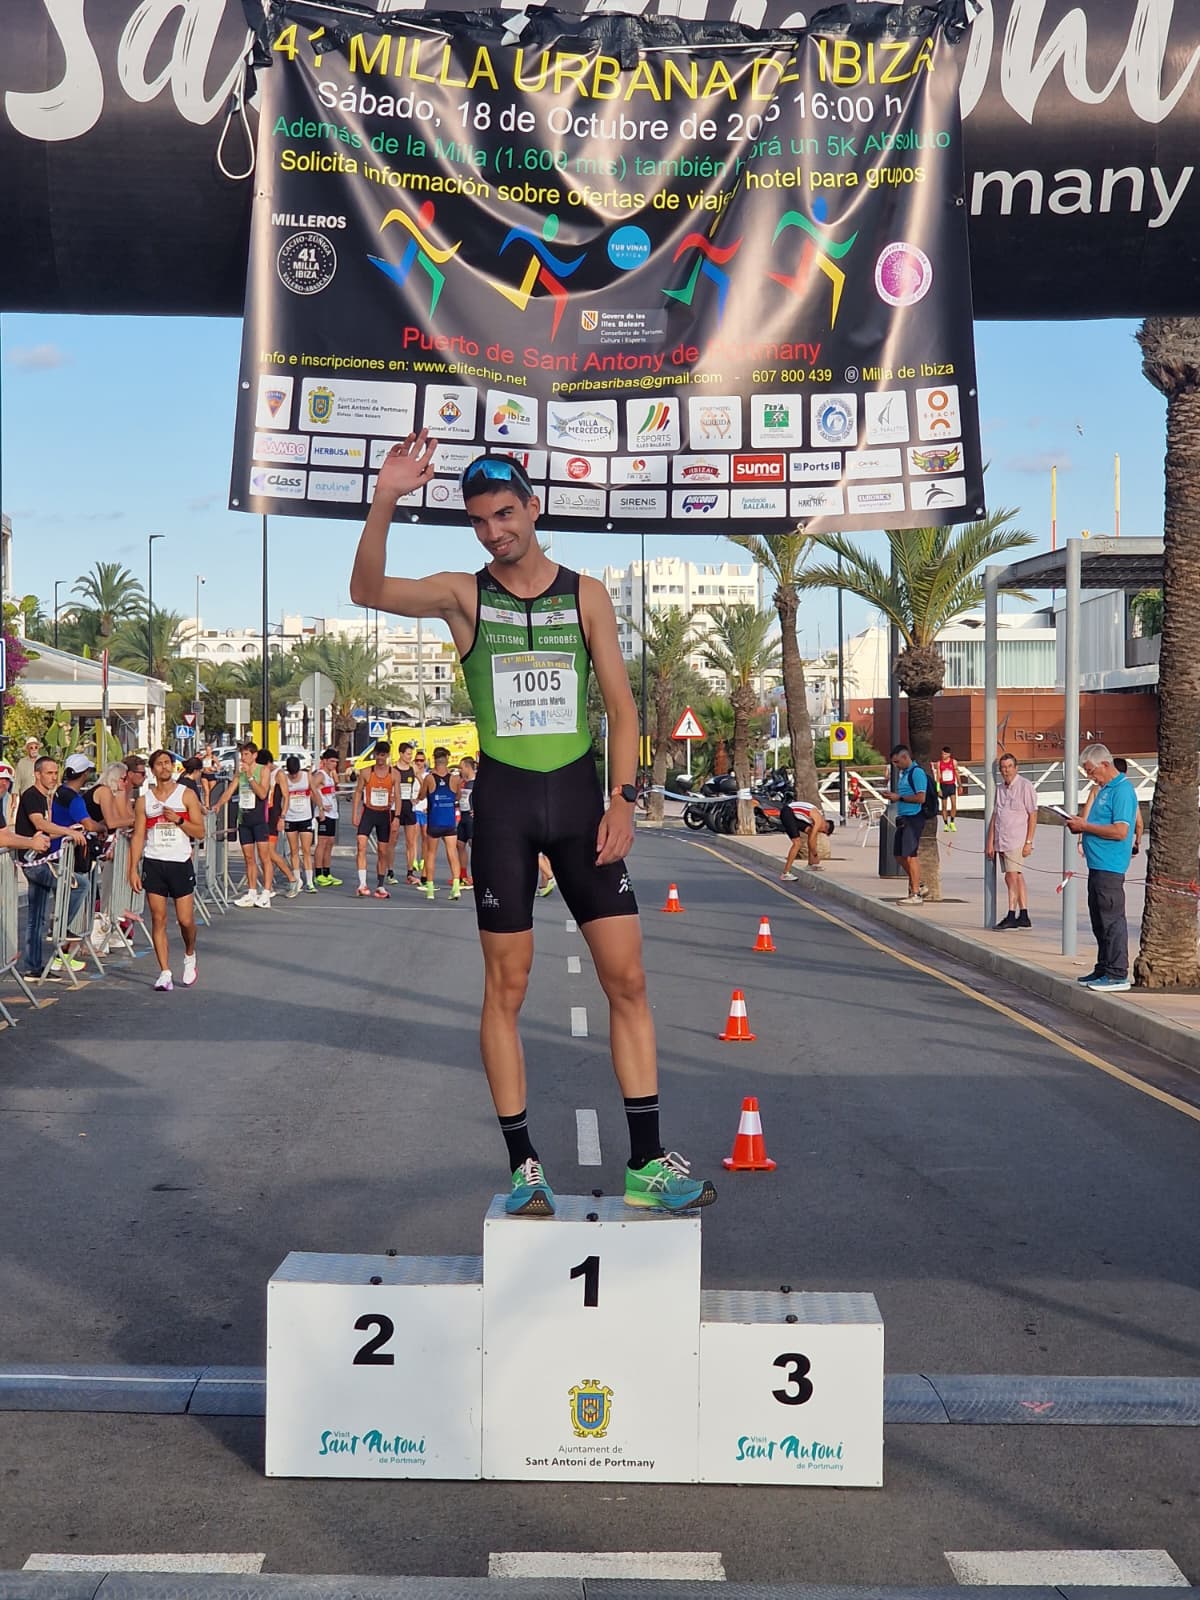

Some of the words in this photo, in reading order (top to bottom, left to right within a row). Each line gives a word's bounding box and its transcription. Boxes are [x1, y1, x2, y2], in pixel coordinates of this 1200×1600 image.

[349, 33, 499, 90] MILLA
[513, 47, 738, 102] URBANA
[819, 37, 935, 84] IBIZA
[317, 81, 441, 127] Sábado,
[457, 101, 491, 130] 18
[500, 104, 536, 132] de
[547, 107, 669, 140] Octubre
[679, 113, 717, 141] de
[726, 96, 780, 141] 205
[793, 92, 874, 123] 16:00
[885, 94, 902, 117] h
[272, 115, 363, 149] Además
[370, 131, 399, 155] de
[406, 134, 427, 157] la
[434, 138, 487, 168] Milla
[495, 147, 569, 173] (1.609
[576, 155, 627, 182] mts)
[634, 154, 727, 179] también
[790, 138, 819, 155] un
[827, 135, 858, 157] 5K
[864, 128, 951, 155] Absoluto
[280, 149, 358, 174] Solicita
[364, 162, 490, 198] información
[497, 182, 560, 204] sobre
[567, 185, 646, 209] ofertas
[653, 189, 680, 209] de
[745, 167, 802, 189] hotel
[809, 169, 859, 191] para
[866, 166, 927, 189] grupos
[271, 213, 347, 229] MILLEROS
[298, 248, 317, 262] 41
[292, 261, 320, 270] MILLA
[295, 270, 317, 279] IBIZA
[601, 312, 625, 320] Govern
[601, 320, 616, 328] Illes
[618, 320, 645, 328] Balears
[402, 326, 480, 357] Puerto
[485, 341, 515, 364] de
[522, 347, 578, 371] Sant
[582, 351, 665, 373] Antony
[671, 343, 700, 365] de
[260, 351, 286, 364] Info
[288, 355, 297, 365] e
[301, 353, 385, 370] inscripciones
[388, 360, 410, 371] en:
[412, 361, 527, 386] www.elitechip.net
[862, 367, 893, 381] Milla
[897, 364, 916, 379] de
[920, 362, 954, 377] Ibiza
[752, 369, 777, 383] 607
[780, 368, 805, 383] 800
[808, 368, 832, 382] 439
[552, 372, 723, 393] pepribasribas@gmail.com
[578, 419, 598, 427] VILLA
[568, 426, 609, 434] MERCEDES
[636, 434, 671, 442] ESPORTS
[314, 447, 349, 456] HERBUSA
[736, 463, 780, 474] suma
[267, 475, 302, 486] Class
[621, 498, 656, 506] SIRENIS
[538, 633, 577, 645] CORDOBÉS
[513, 670, 561, 693] 1005
[509, 698, 536, 708] Francisco
[570, 1255, 600, 1307] 1
[353, 1313, 395, 1365] 2
[771, 1352, 814, 1406] 3
[318, 1430, 360, 1456] Sant
[362, 1429, 426, 1456] Antoni
[735, 1436, 778, 1461] Sant
[780, 1435, 844, 1461] Antoni
[558, 1445, 609, 1454] Ajuntament
[612, 1445, 623, 1453] de
[390, 1457, 426, 1466] Portmany
[525, 1457, 548, 1466] Sant
[551, 1457, 587, 1466] Antoni
[589, 1457, 602, 1467] de
[604, 1458, 655, 1469] Portmany
[808, 1462, 844, 1471] Portmany
